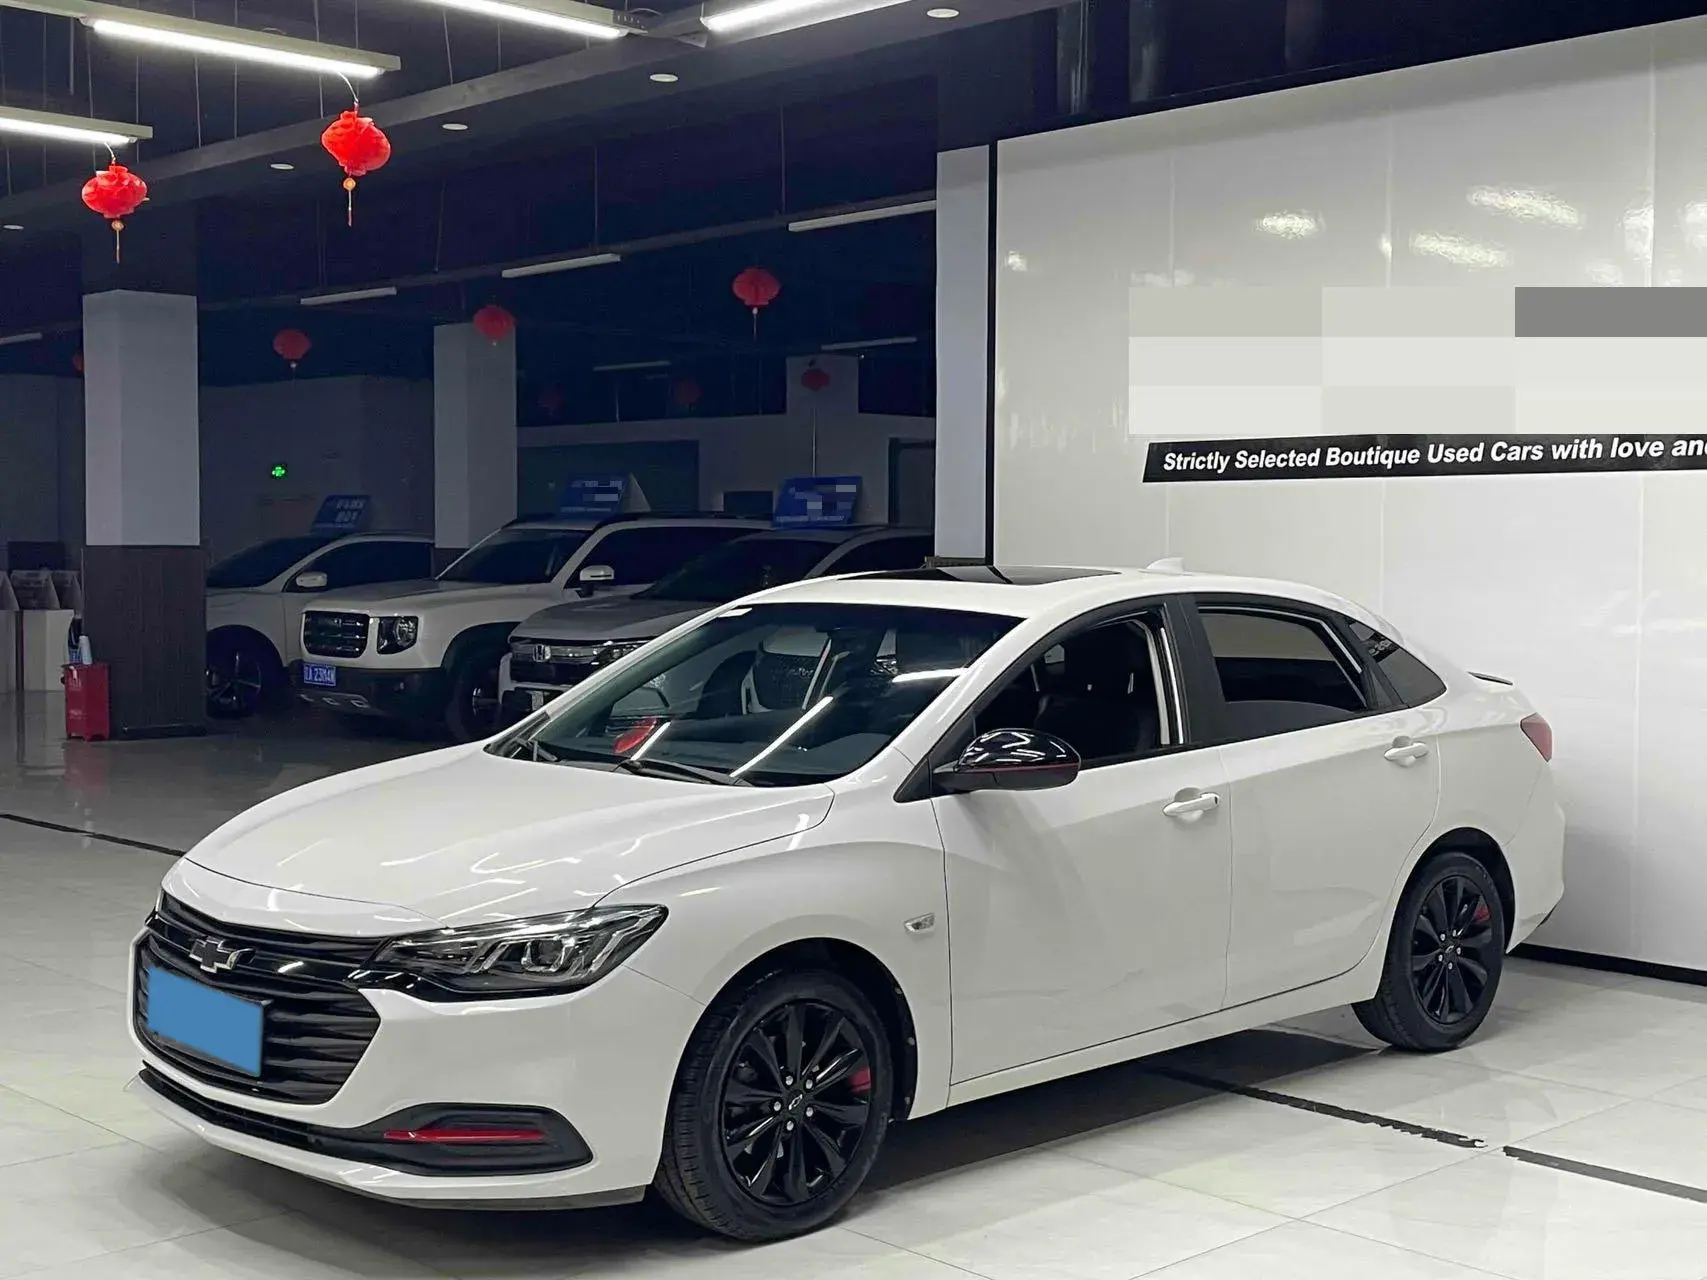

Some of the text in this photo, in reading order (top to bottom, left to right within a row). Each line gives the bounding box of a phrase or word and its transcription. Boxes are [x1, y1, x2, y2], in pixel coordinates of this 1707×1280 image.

[1163, 437, 1707, 474] Strictly Selected Boutique Used Cars with love an
